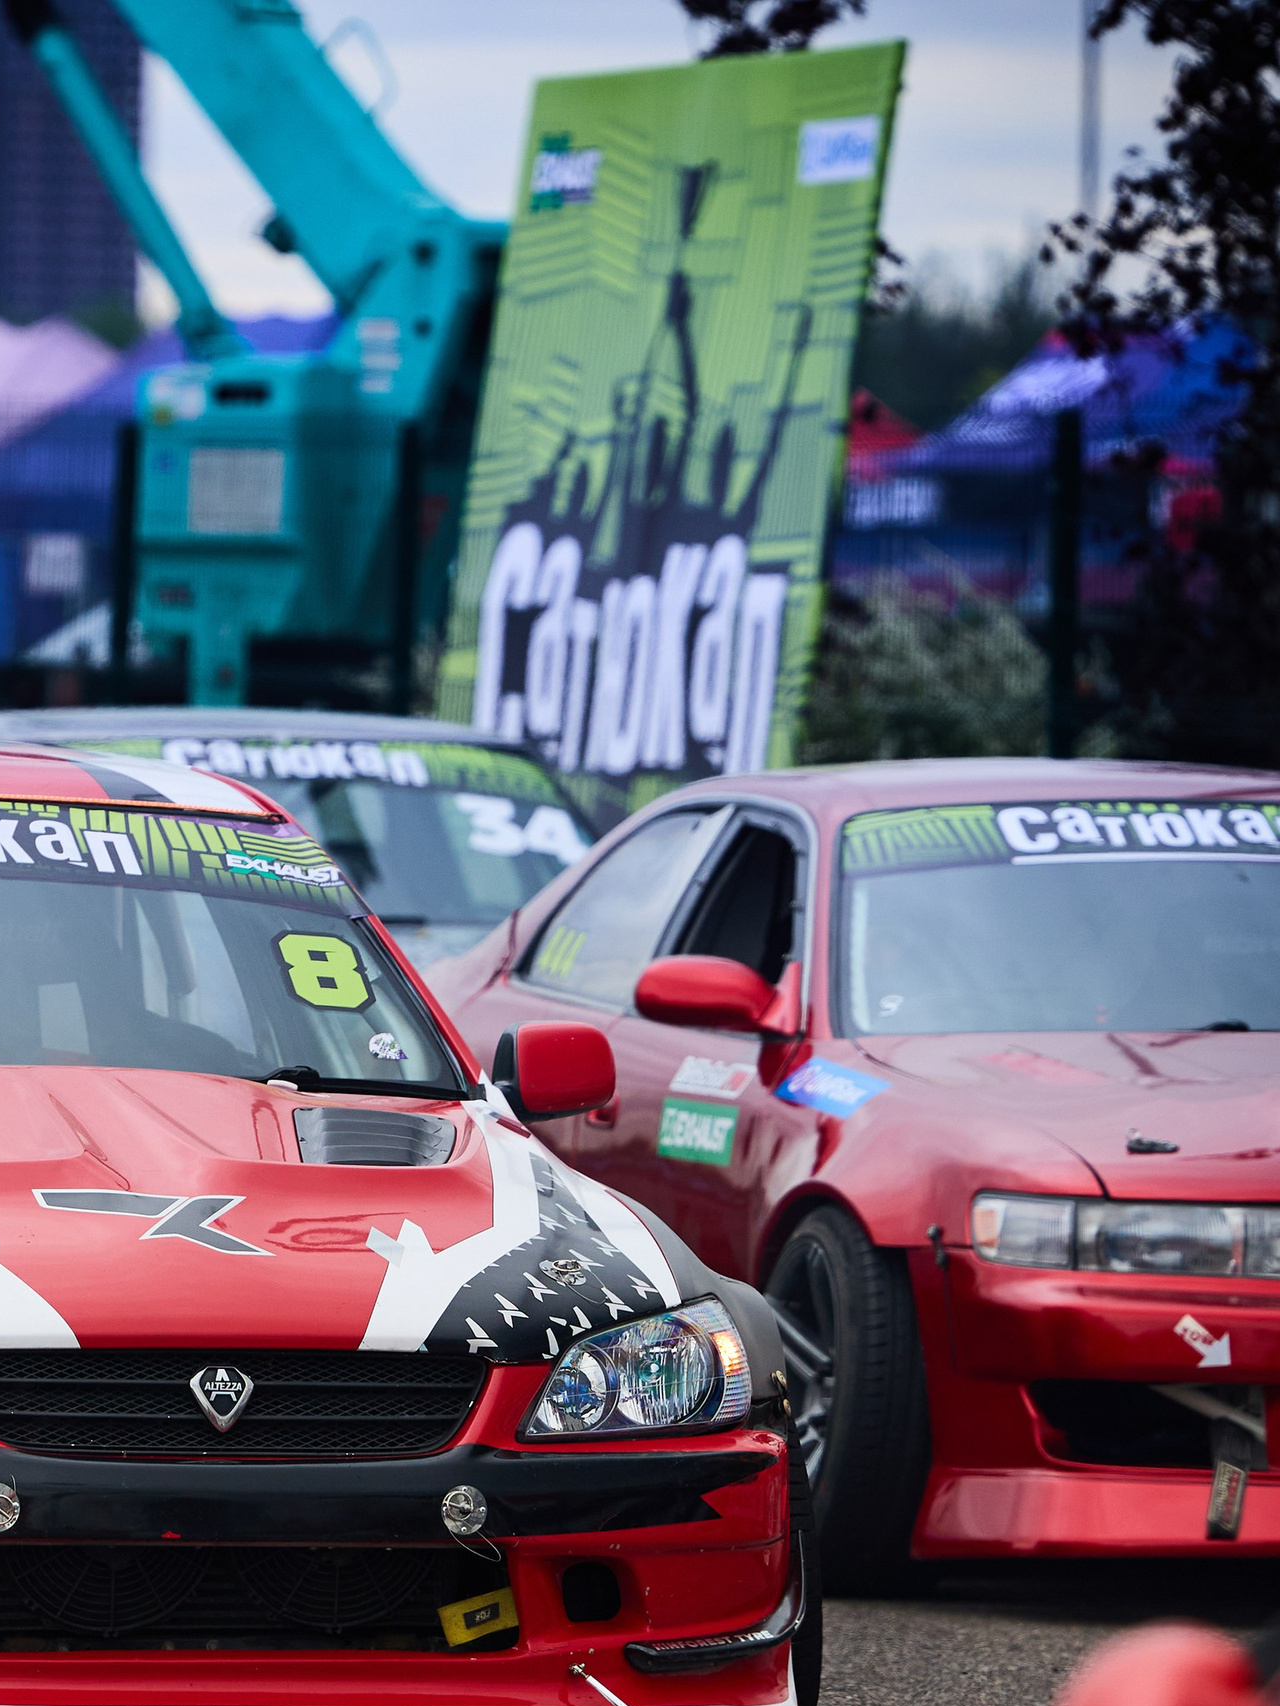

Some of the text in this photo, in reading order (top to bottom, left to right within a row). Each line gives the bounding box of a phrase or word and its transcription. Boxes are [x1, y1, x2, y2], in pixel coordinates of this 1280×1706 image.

[997, 806, 1280, 854] Сатюка
[225, 853, 341, 882] EXHAUST
[276, 932, 370, 1009] 8
[204, 1381, 243, 1392] ALTEZZA
[651, 1629, 775, 1652] KINFOREST TYRE
